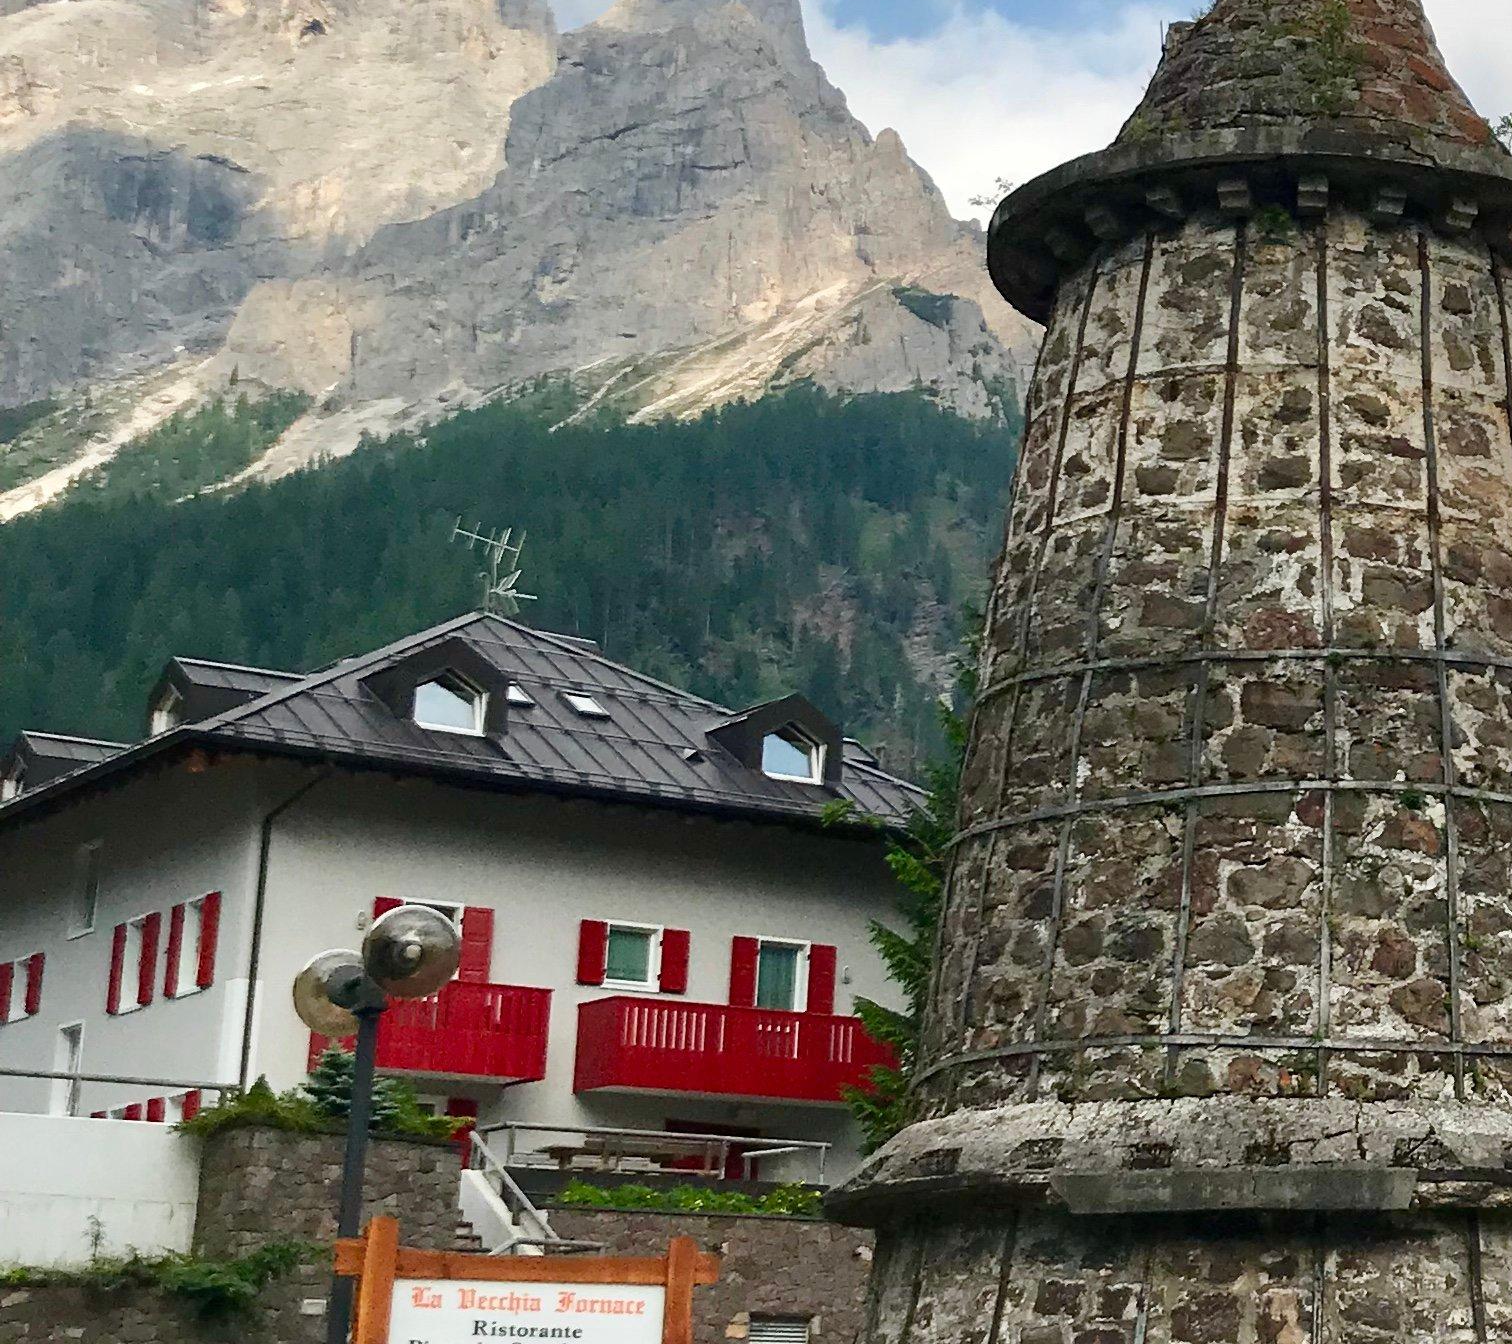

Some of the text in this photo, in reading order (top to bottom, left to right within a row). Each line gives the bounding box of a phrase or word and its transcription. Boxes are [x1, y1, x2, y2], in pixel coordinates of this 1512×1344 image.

[411, 1286, 646, 1316] La Vecchia Fornace
[472, 1319, 583, 1339] Ristorante
